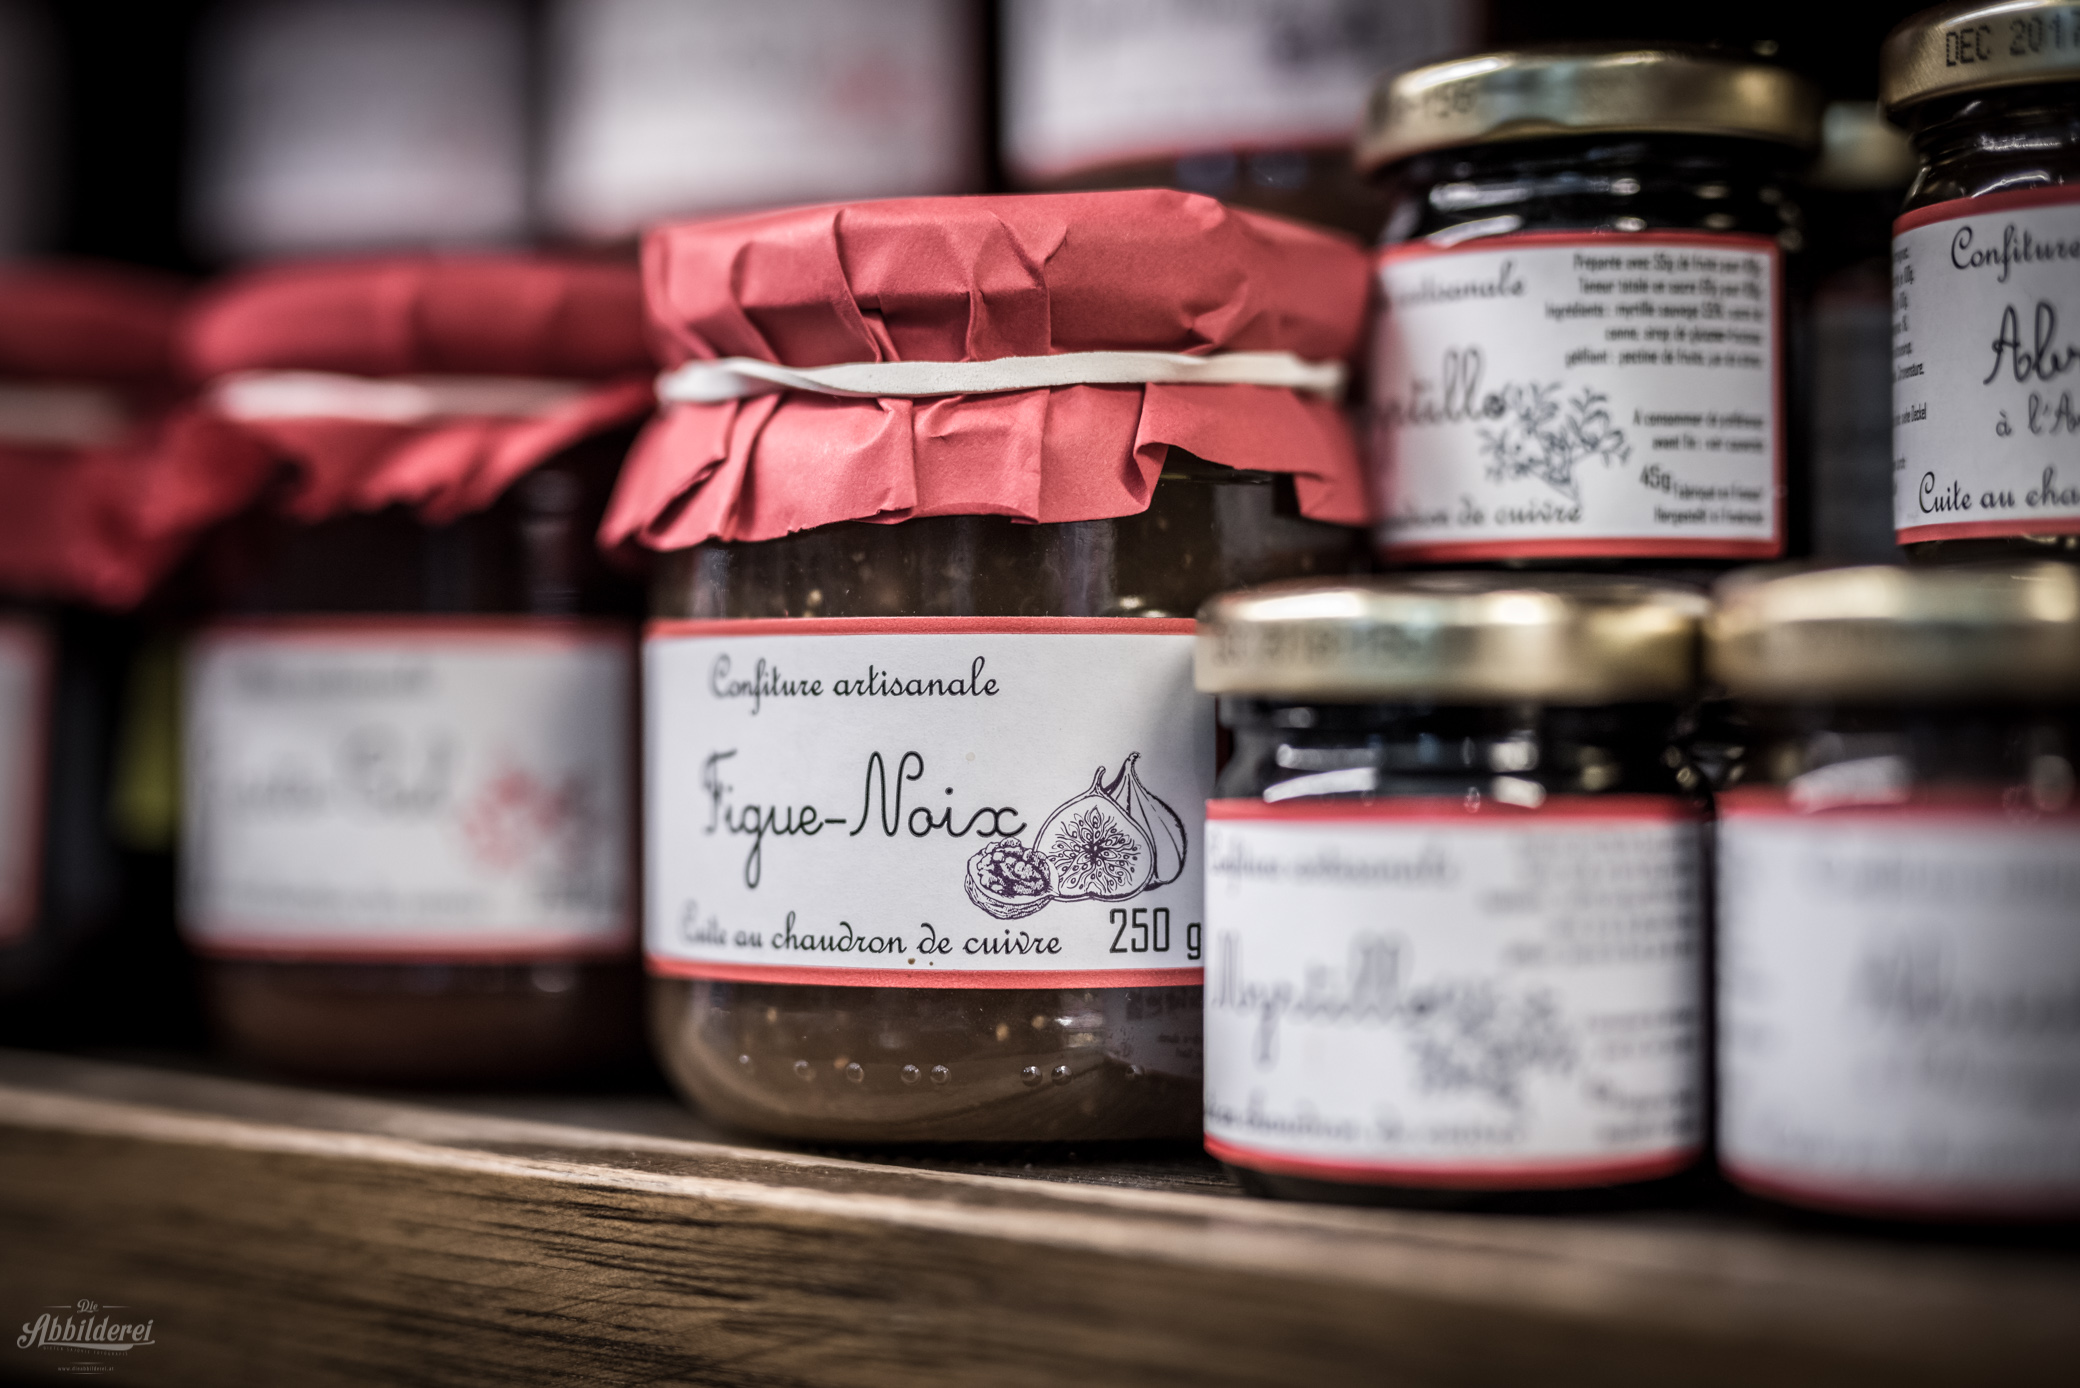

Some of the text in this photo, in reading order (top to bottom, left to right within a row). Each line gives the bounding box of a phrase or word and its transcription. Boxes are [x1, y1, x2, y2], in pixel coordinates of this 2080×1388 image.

[1946, 24, 1992, 67] DEC
[1950, 224, 2080, 284] Confiture
[1996, 409, 2013, 437] à
[1639, 463, 1672, 495] 45g
[1918, 471, 1972, 514] Cuite
[1979, 491, 2016, 510] au
[709, 653, 1000, 716] Confiture artisanale
[702, 747, 1027, 890] Figue-Noix
[734, 928, 764, 948] au
[770, 910, 907, 954] chaudron
[916, 922, 953, 955] de
[962, 929, 1062, 955] cuivre
[1109, 907, 1201, 960] 250 g
